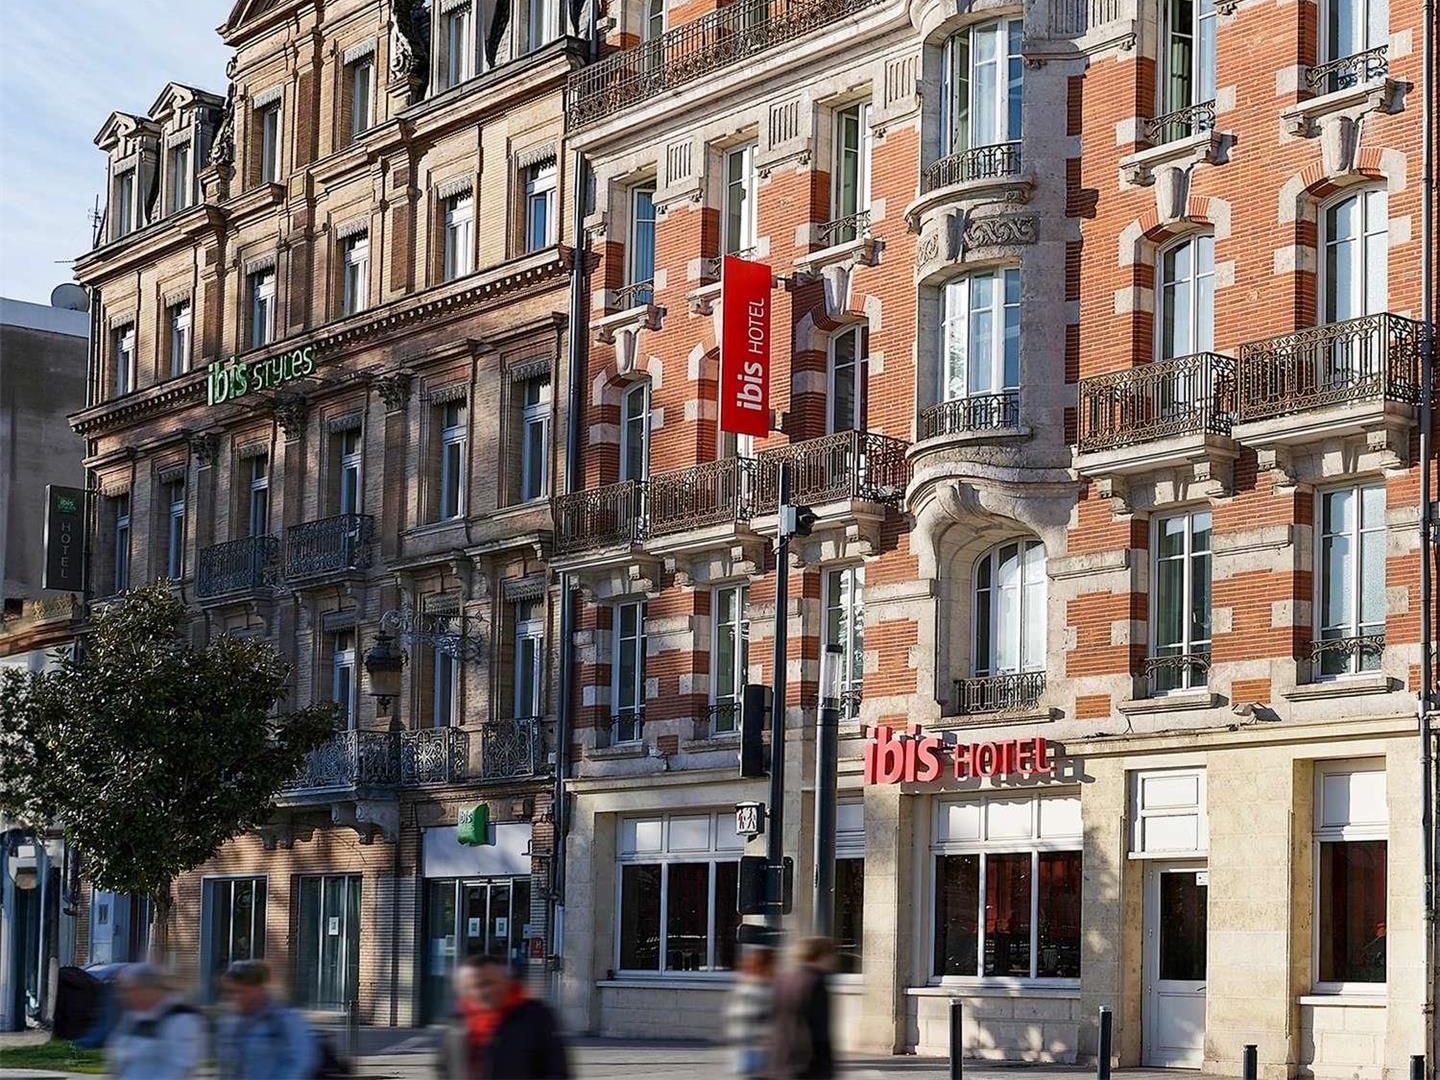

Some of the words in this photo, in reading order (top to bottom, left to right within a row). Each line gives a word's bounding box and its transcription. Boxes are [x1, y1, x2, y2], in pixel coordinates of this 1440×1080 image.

[748, 297, 765, 355] HOTEL
[207, 355, 248, 407] ibis
[736, 361, 763, 412] ibis
[61, 522, 71, 578] HOTEL
[863, 724, 943, 785] ibis
[953, 736, 1053, 779] HOTEL
